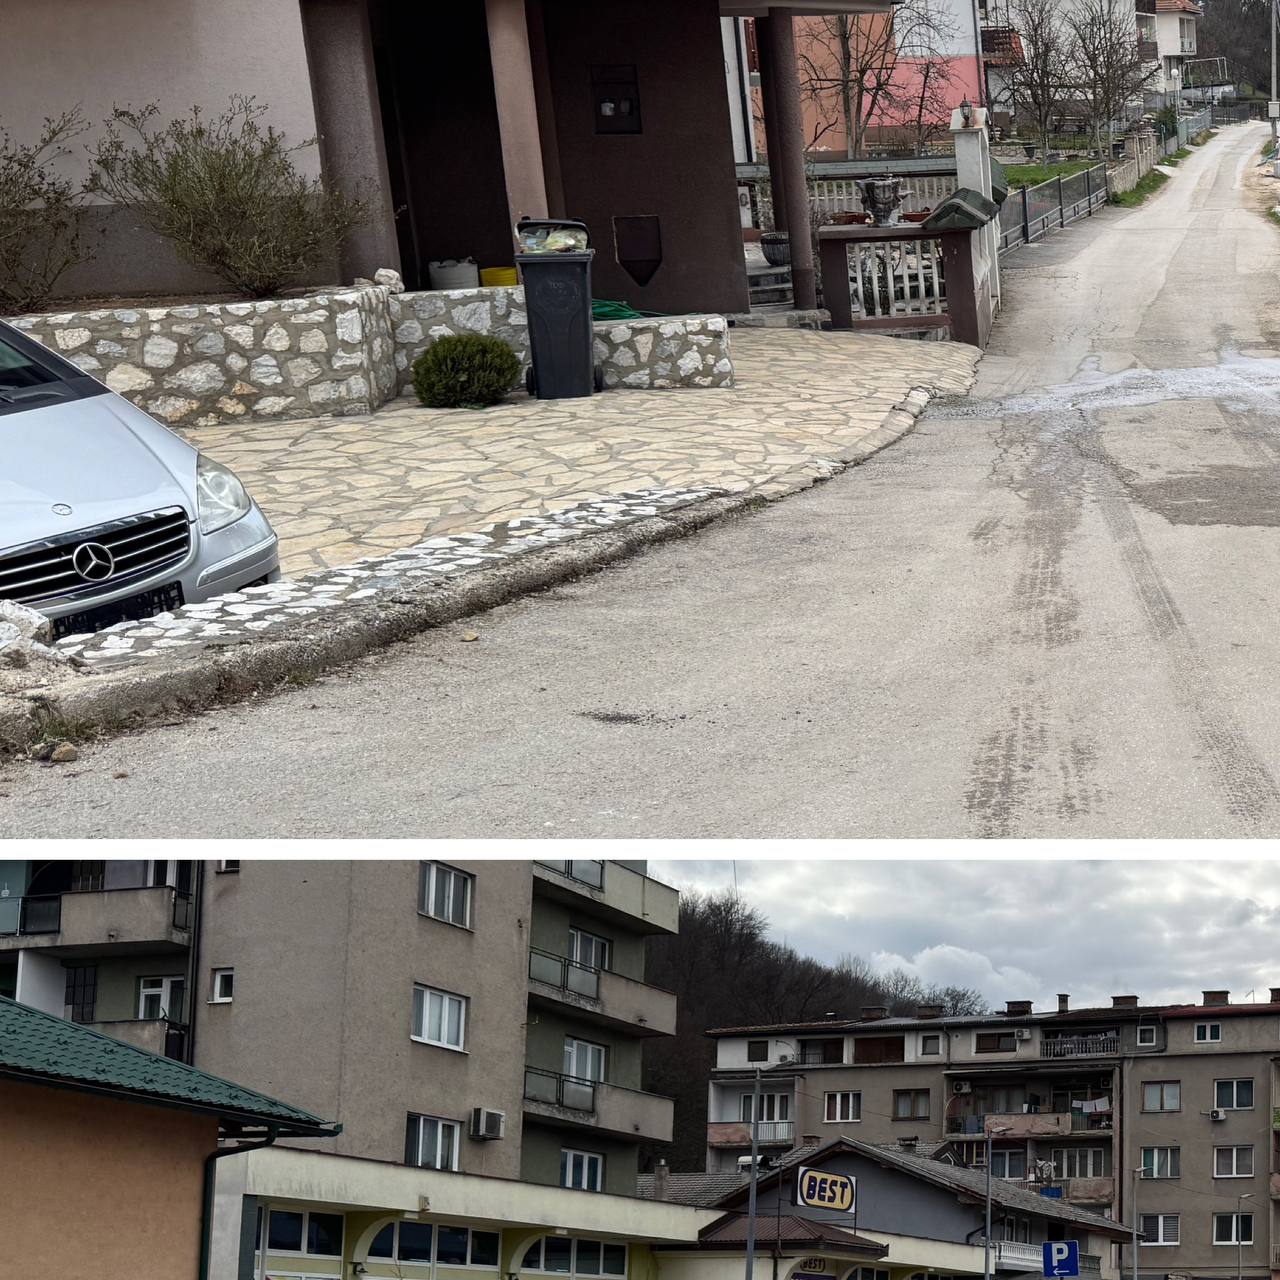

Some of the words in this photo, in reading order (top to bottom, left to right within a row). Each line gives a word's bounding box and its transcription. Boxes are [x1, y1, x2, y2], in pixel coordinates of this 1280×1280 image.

[806, 1175, 849, 1206] BEST
[802, 1257, 825, 1270] BEST
[1051, 1243, 1069, 1267] P
